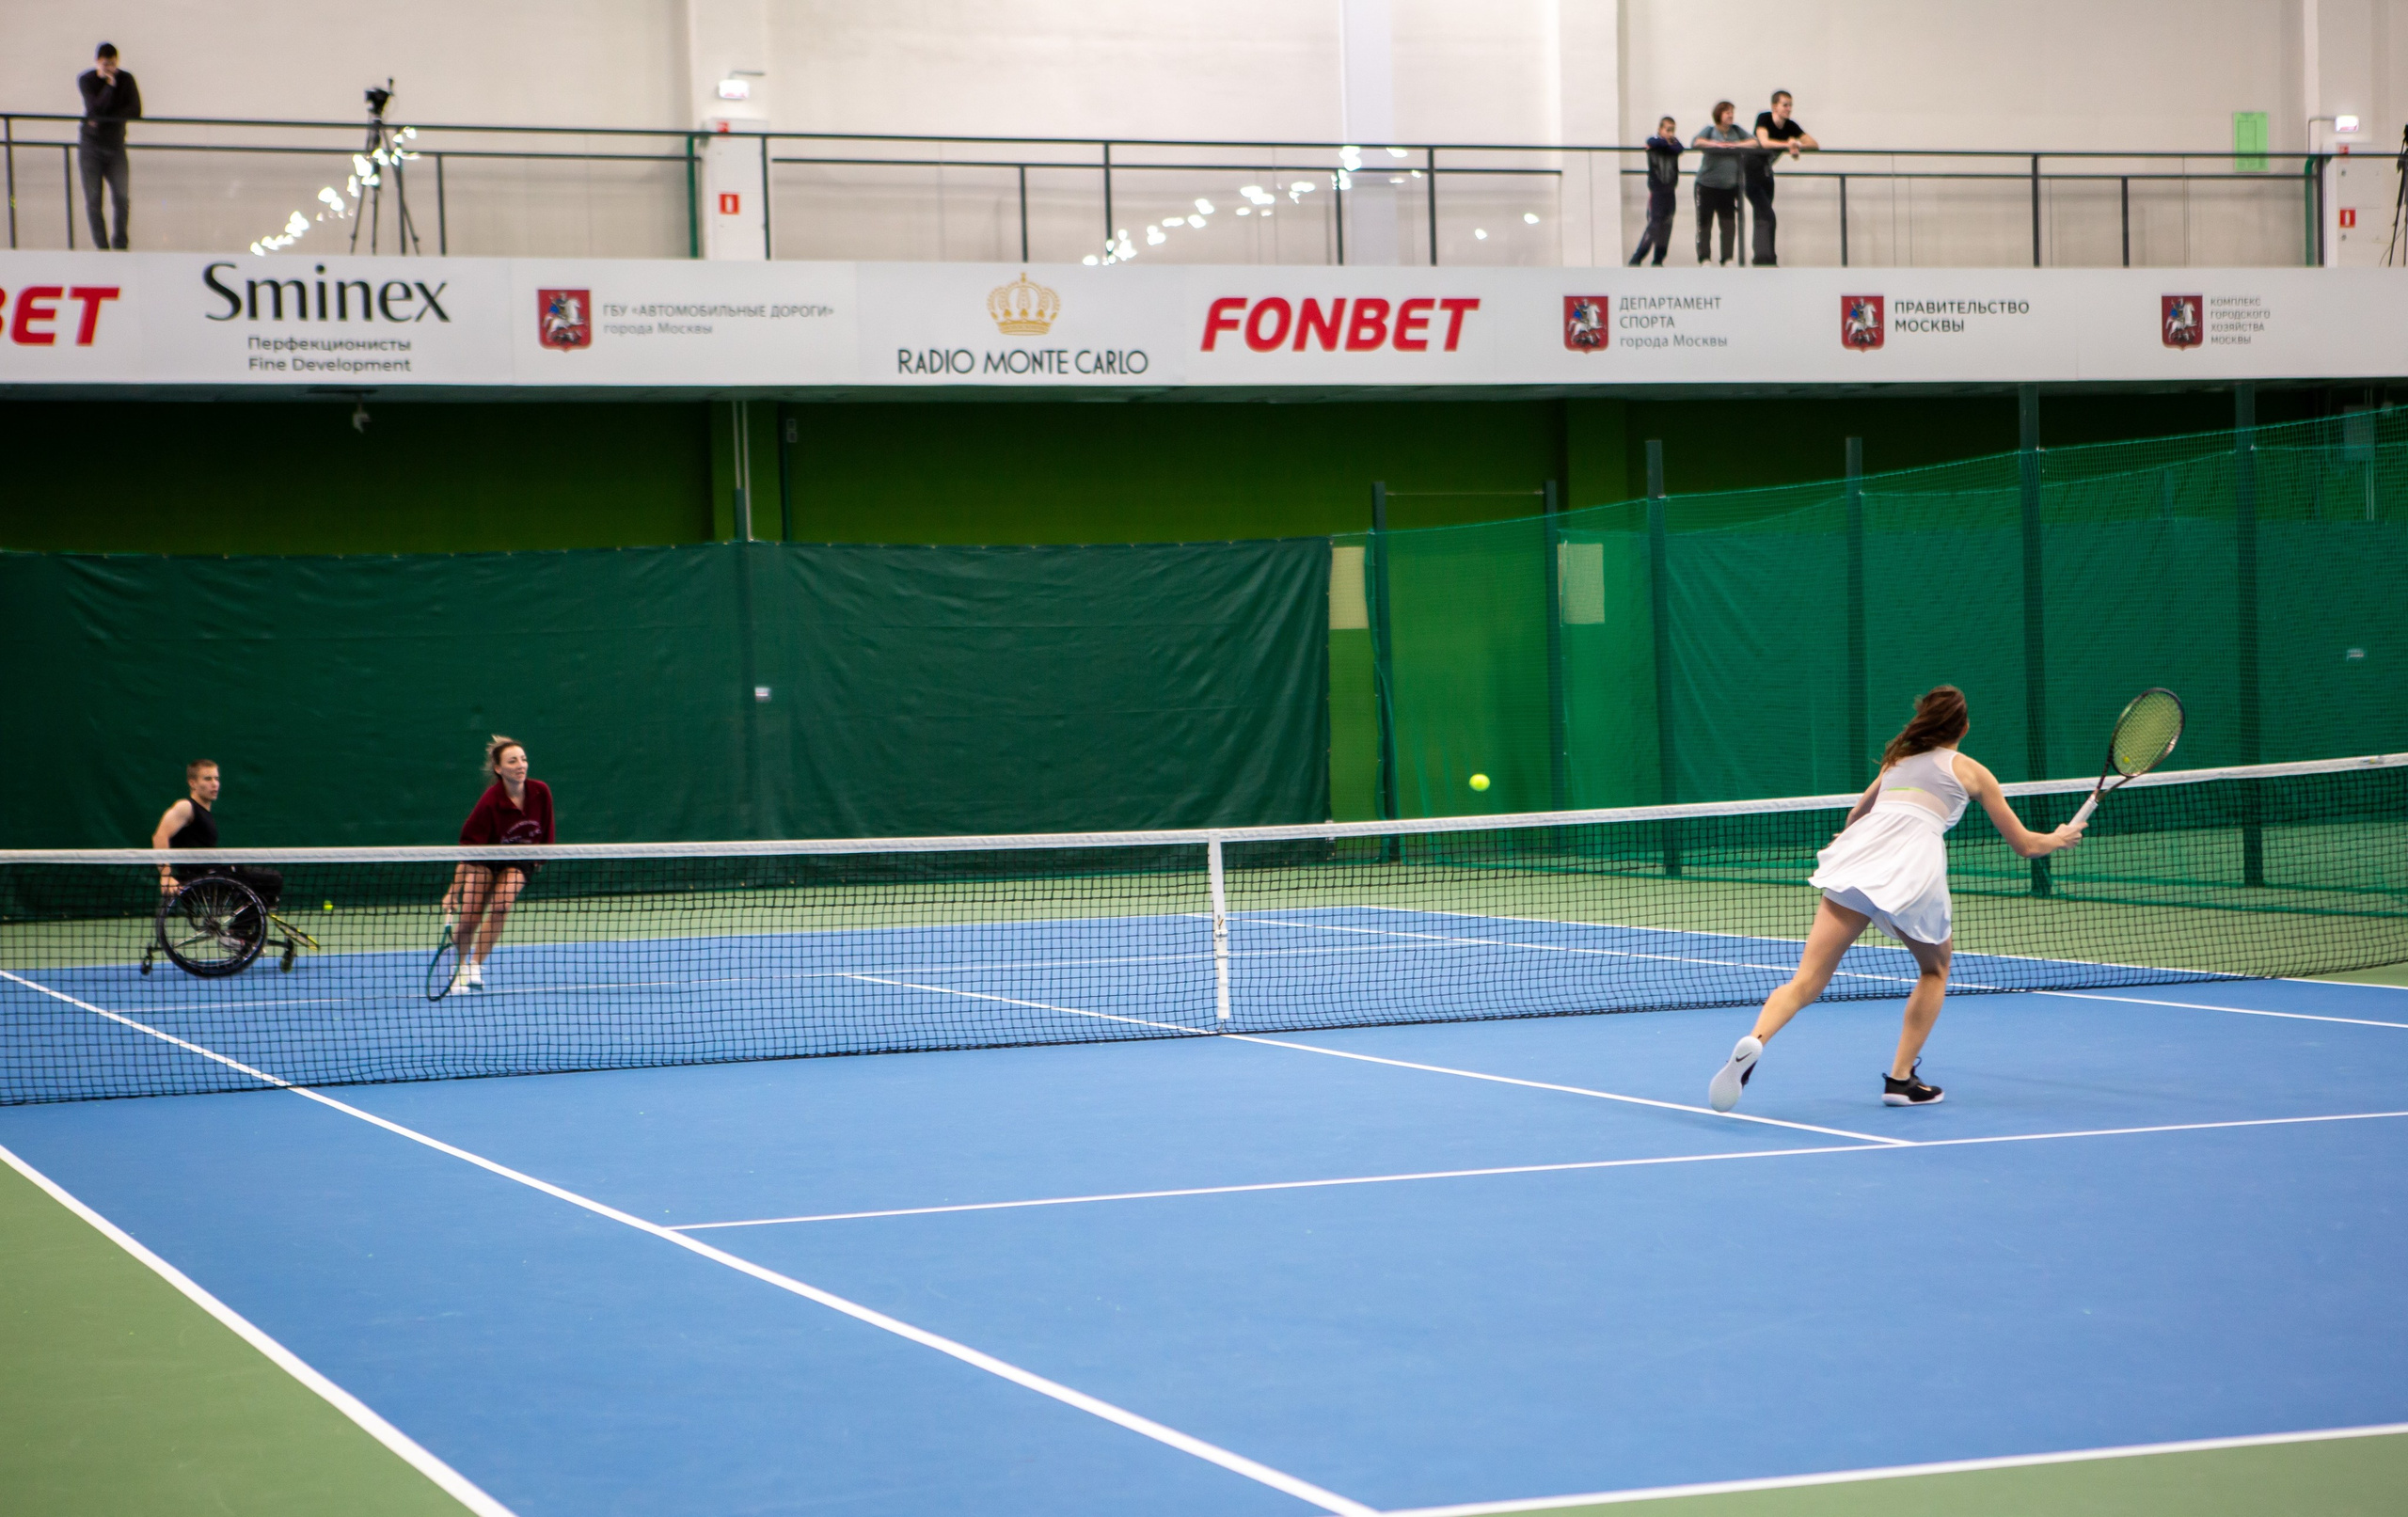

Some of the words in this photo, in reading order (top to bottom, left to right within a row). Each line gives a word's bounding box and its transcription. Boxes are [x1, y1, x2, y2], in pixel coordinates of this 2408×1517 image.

[202, 261, 451, 323] Sminex
[1619, 295, 1722, 312] ДЕПАРТАМЕНТ
[1894, 300, 2030, 315] ПРАВИТЕЛЬСТВО
[2210, 296, 2261, 308] КОМПЛЕКС
[0, 286, 120, 346] ET
[603, 304, 628, 318] ГБУ
[631, 304, 767, 318] «АВТОМОБИЛЬНЫЕ
[769, 304, 834, 320] ДОРОГИ»
[2210, 309, 2271, 320] ГОРОДСКОГО
[603, 324, 654, 337] города
[657, 322, 713, 335] Москвы
[1201, 296, 1481, 354] FONBET
[1619, 314, 1676, 329] СПОРТА
[1894, 319, 1965, 333] МОСКВЫ
[2210, 321, 2265, 333] ХОЗЯЙСТВА
[247, 334, 412, 353] Перфекционисты
[1620, 337, 1669, 350] города
[1673, 334, 1728, 347] Москвы
[2210, 335, 2252, 345] МОСКВЫ
[248, 356, 287, 371] Fine
[292, 356, 411, 374] Development
[897, 348, 975, 374] RADIO
[983, 349, 1069, 374] MONTE
[1074, 349, 1149, 374] CARLO
